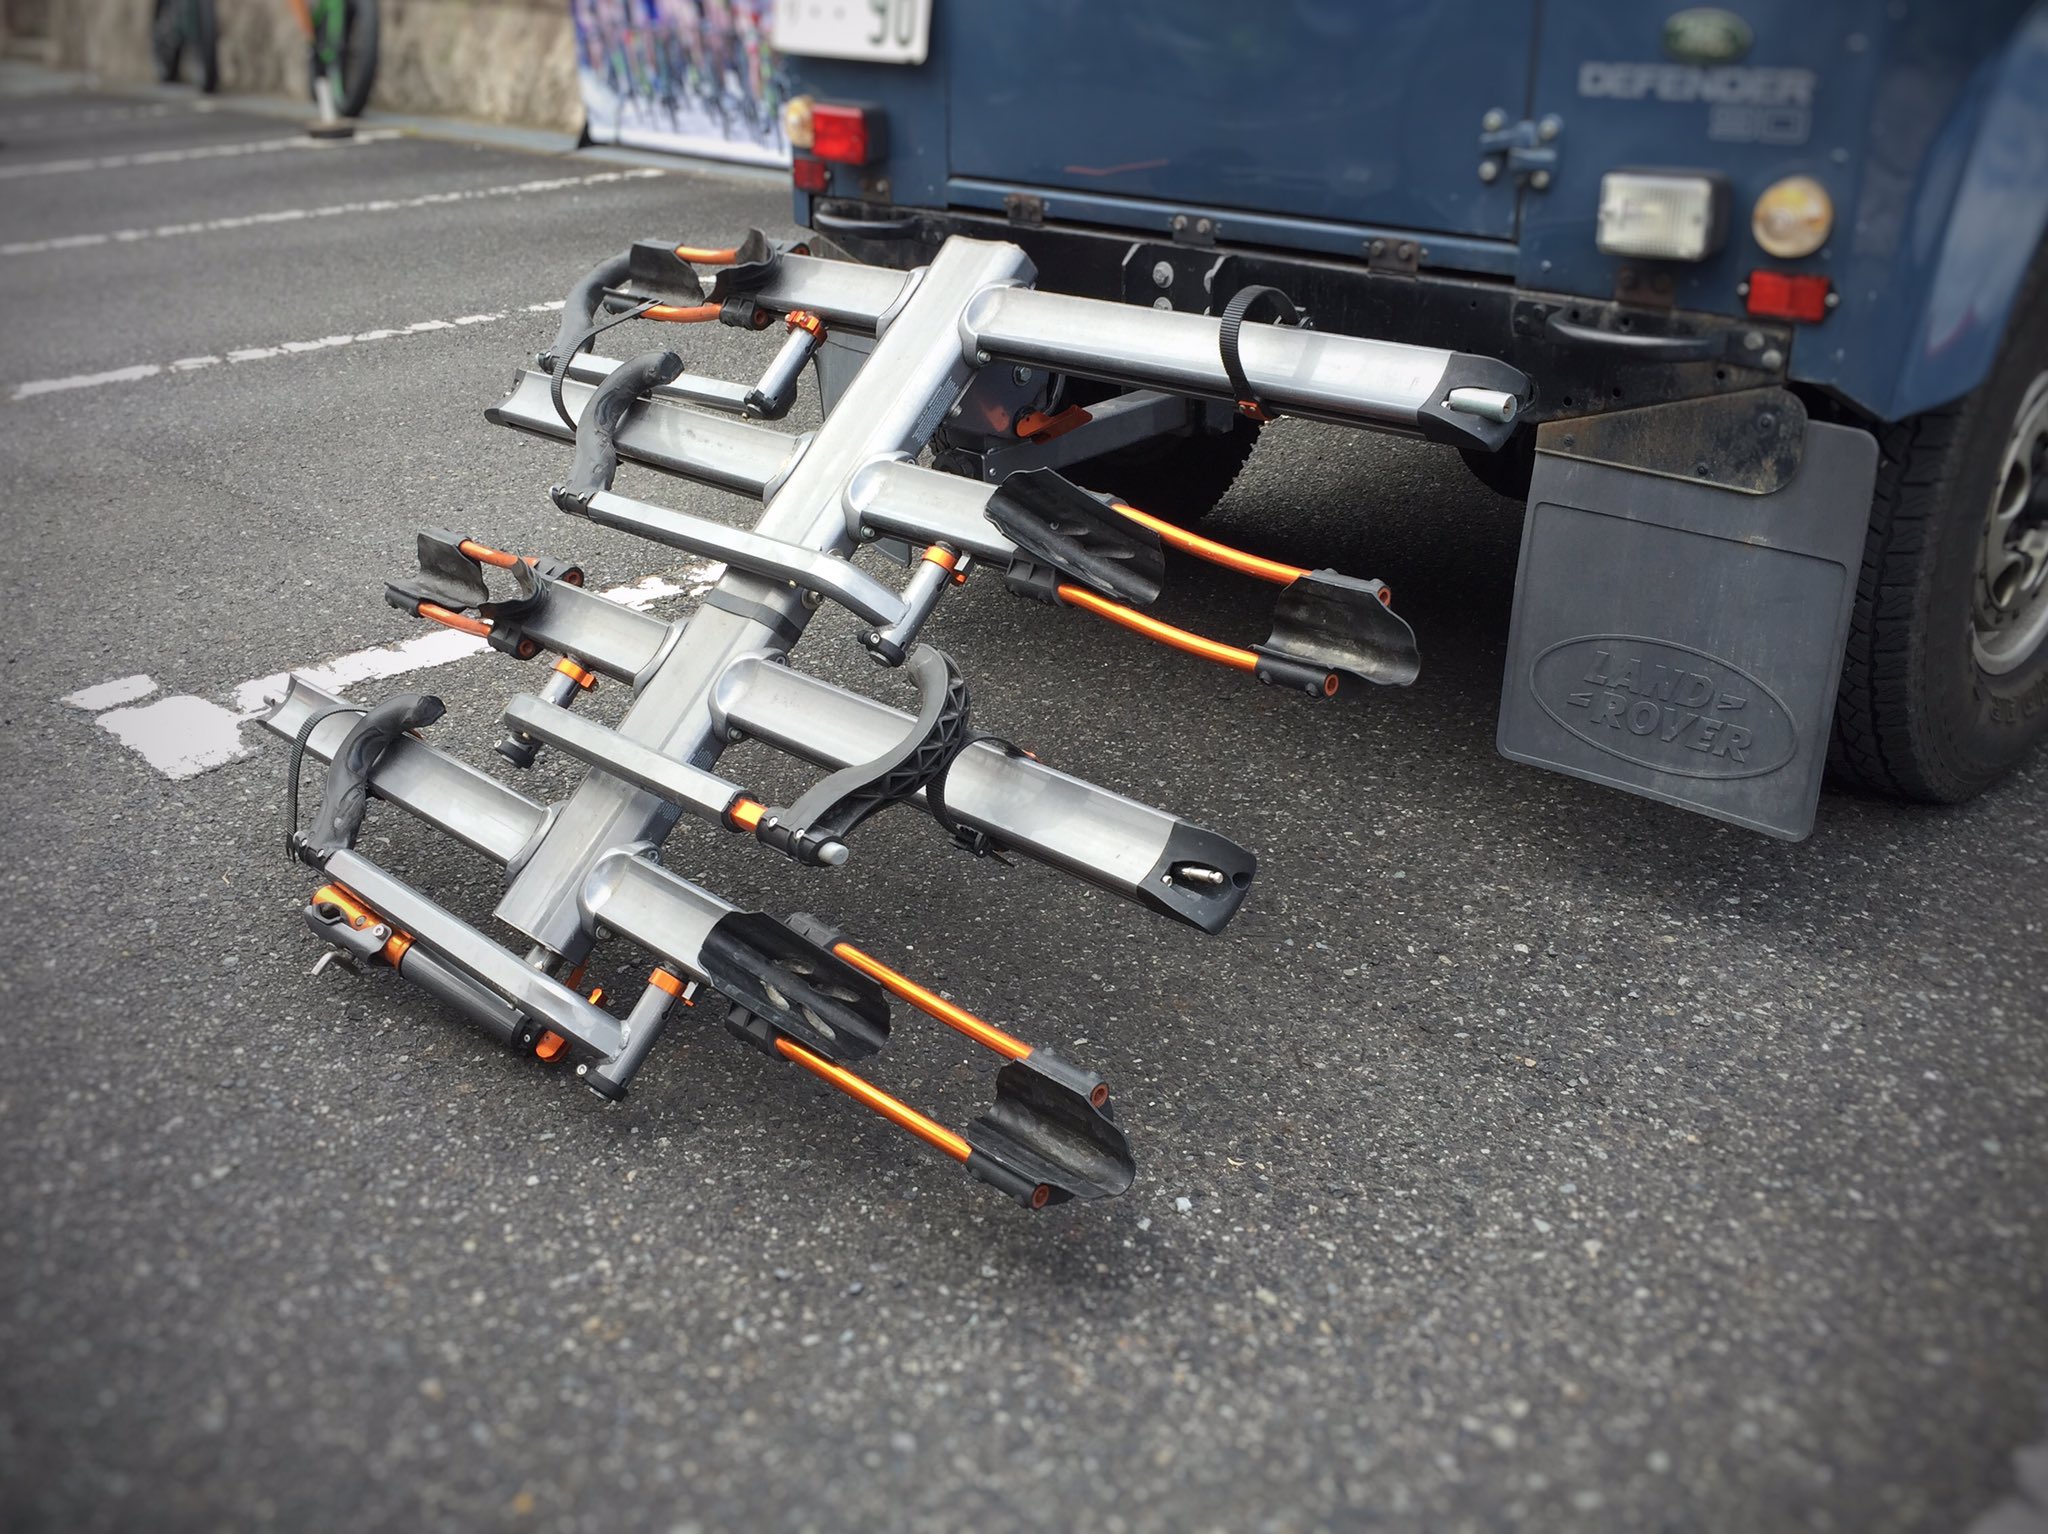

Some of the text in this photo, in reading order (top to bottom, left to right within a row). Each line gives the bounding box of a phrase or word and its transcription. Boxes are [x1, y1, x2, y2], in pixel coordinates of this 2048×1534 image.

[1578, 61, 1816, 106] DEFENDER
[1583, 650, 1716, 709] LAND
[1590, 691, 1753, 763] ROVER
